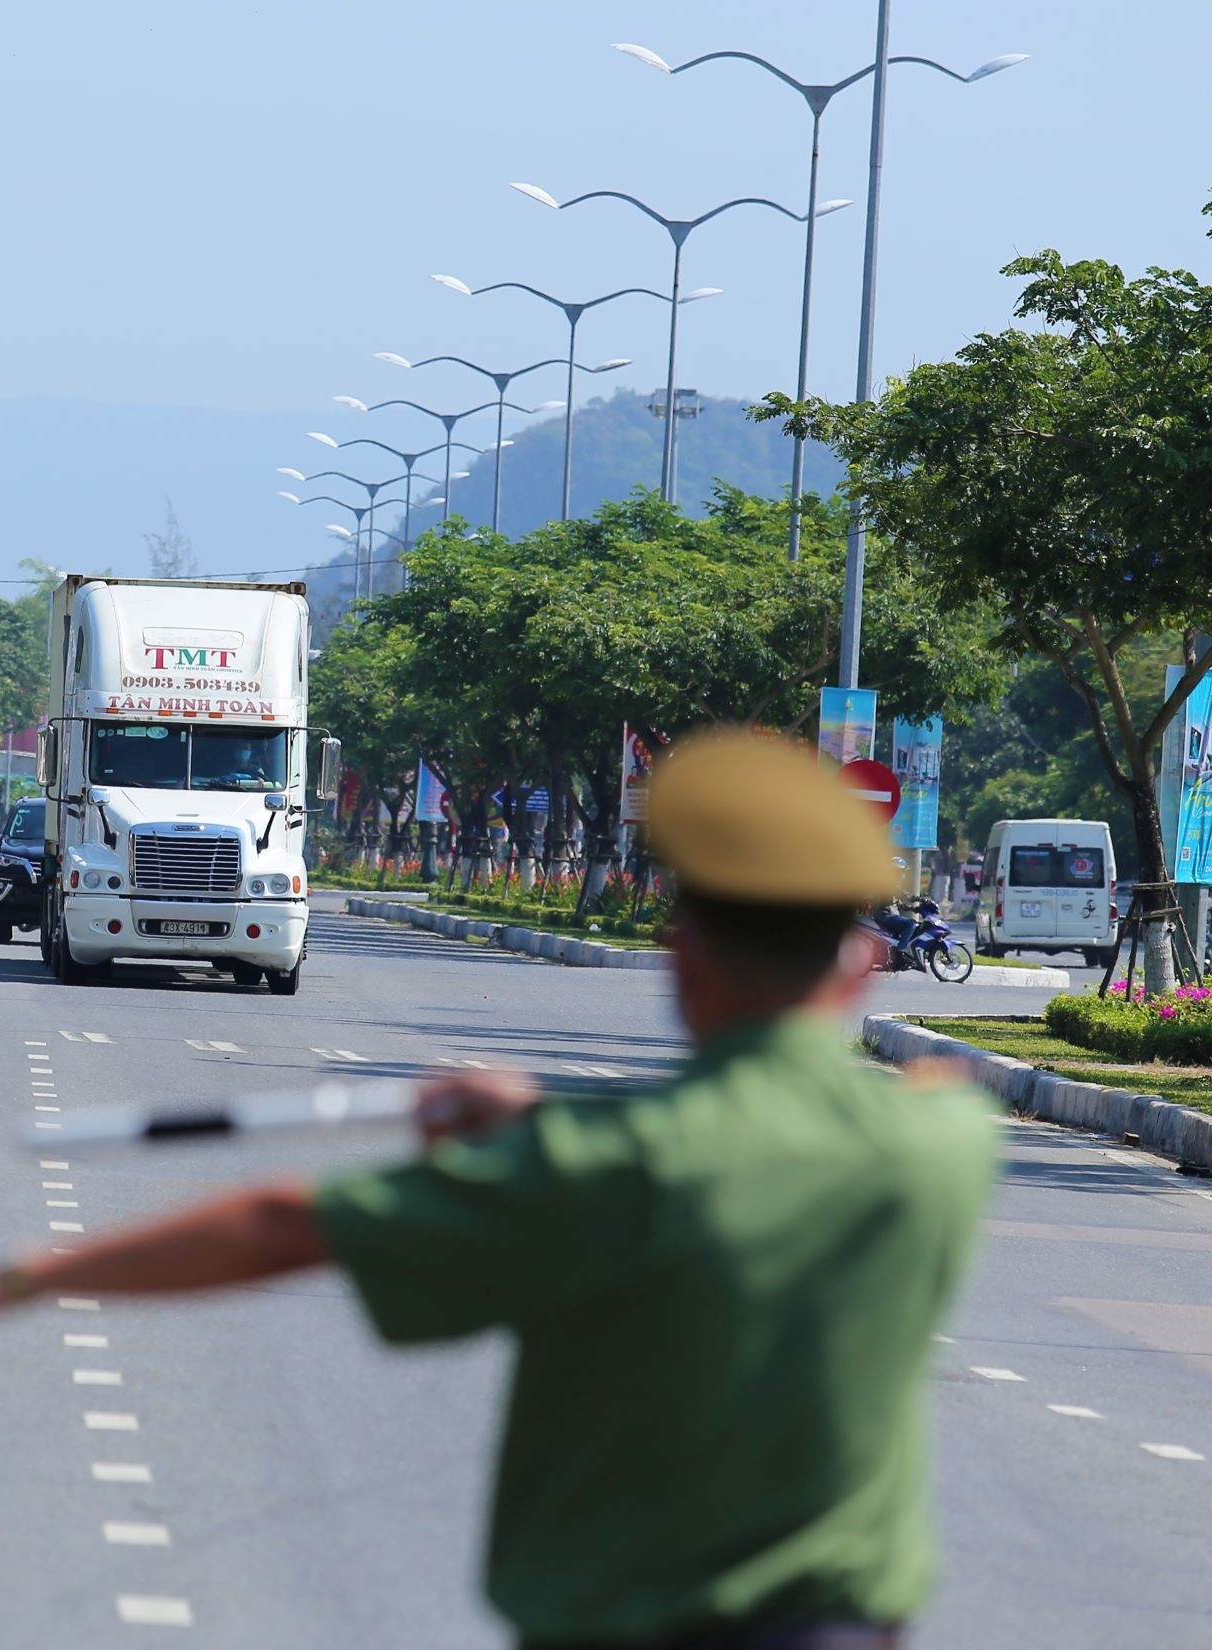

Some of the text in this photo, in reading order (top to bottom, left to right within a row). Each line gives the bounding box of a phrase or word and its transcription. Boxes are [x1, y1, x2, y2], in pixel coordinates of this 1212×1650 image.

[145, 648, 236, 669] TMT
[108, 694, 273, 714] TÂN MINH TOÀN
